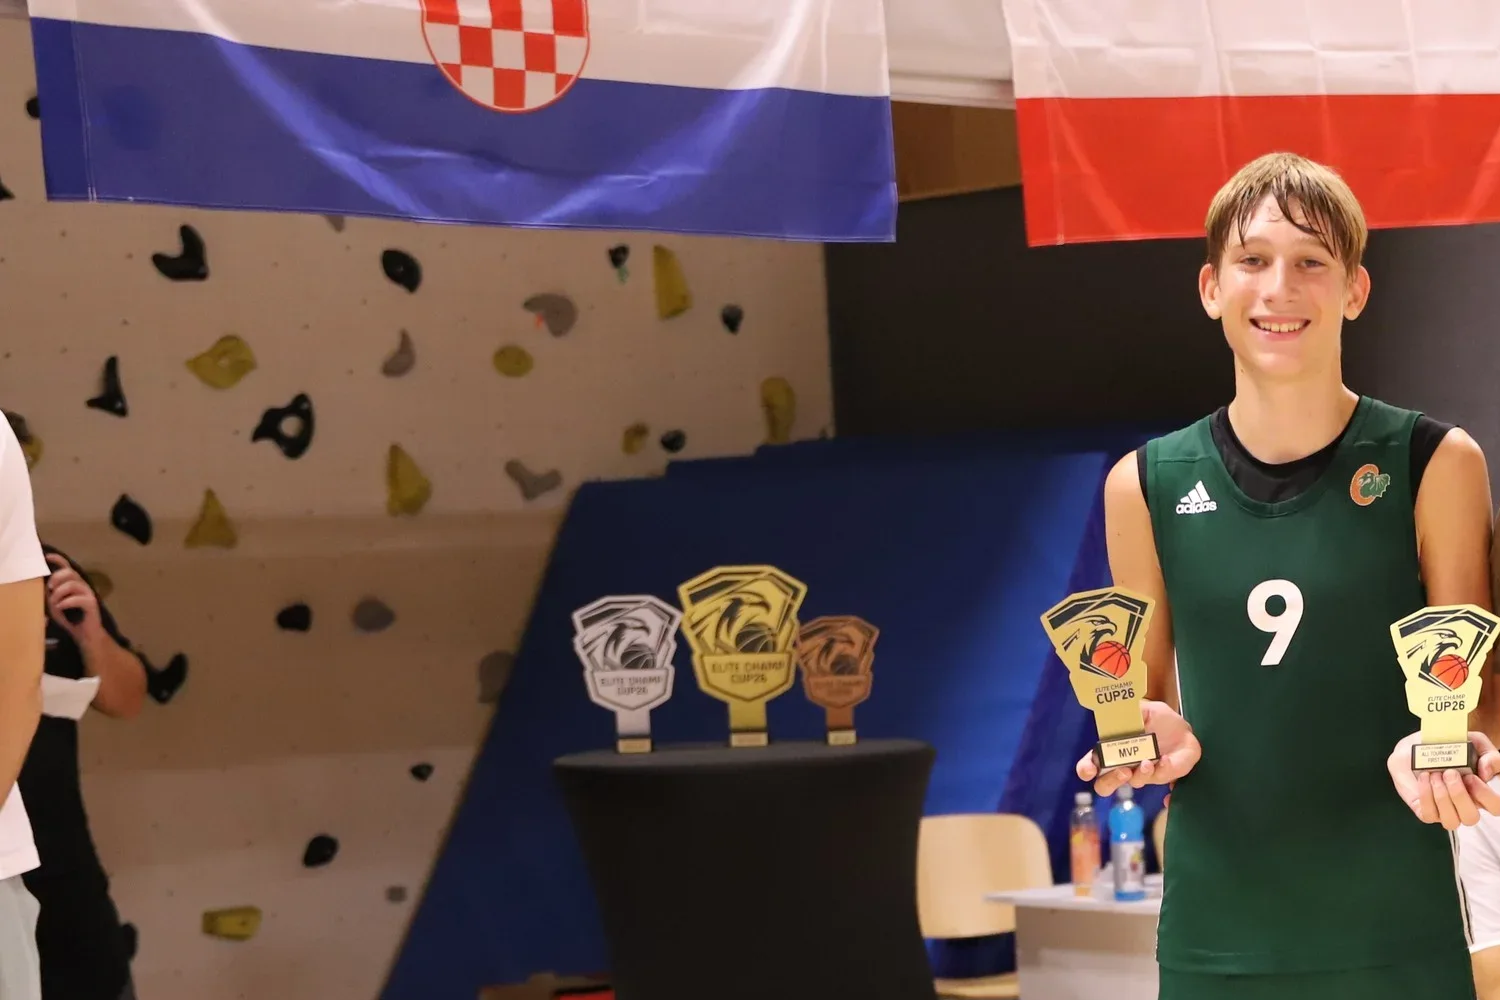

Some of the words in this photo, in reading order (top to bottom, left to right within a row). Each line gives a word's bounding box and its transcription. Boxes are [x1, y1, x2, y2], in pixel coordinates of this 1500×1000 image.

[1176, 500, 1218, 515] adidas
[1247, 579, 1304, 666] 9
[1111, 681, 1132, 690] CHAMP
[1097, 688, 1134, 704] CUP26
[1428, 700, 1464, 712] CUP26
[1118, 746, 1139, 757] MVP
